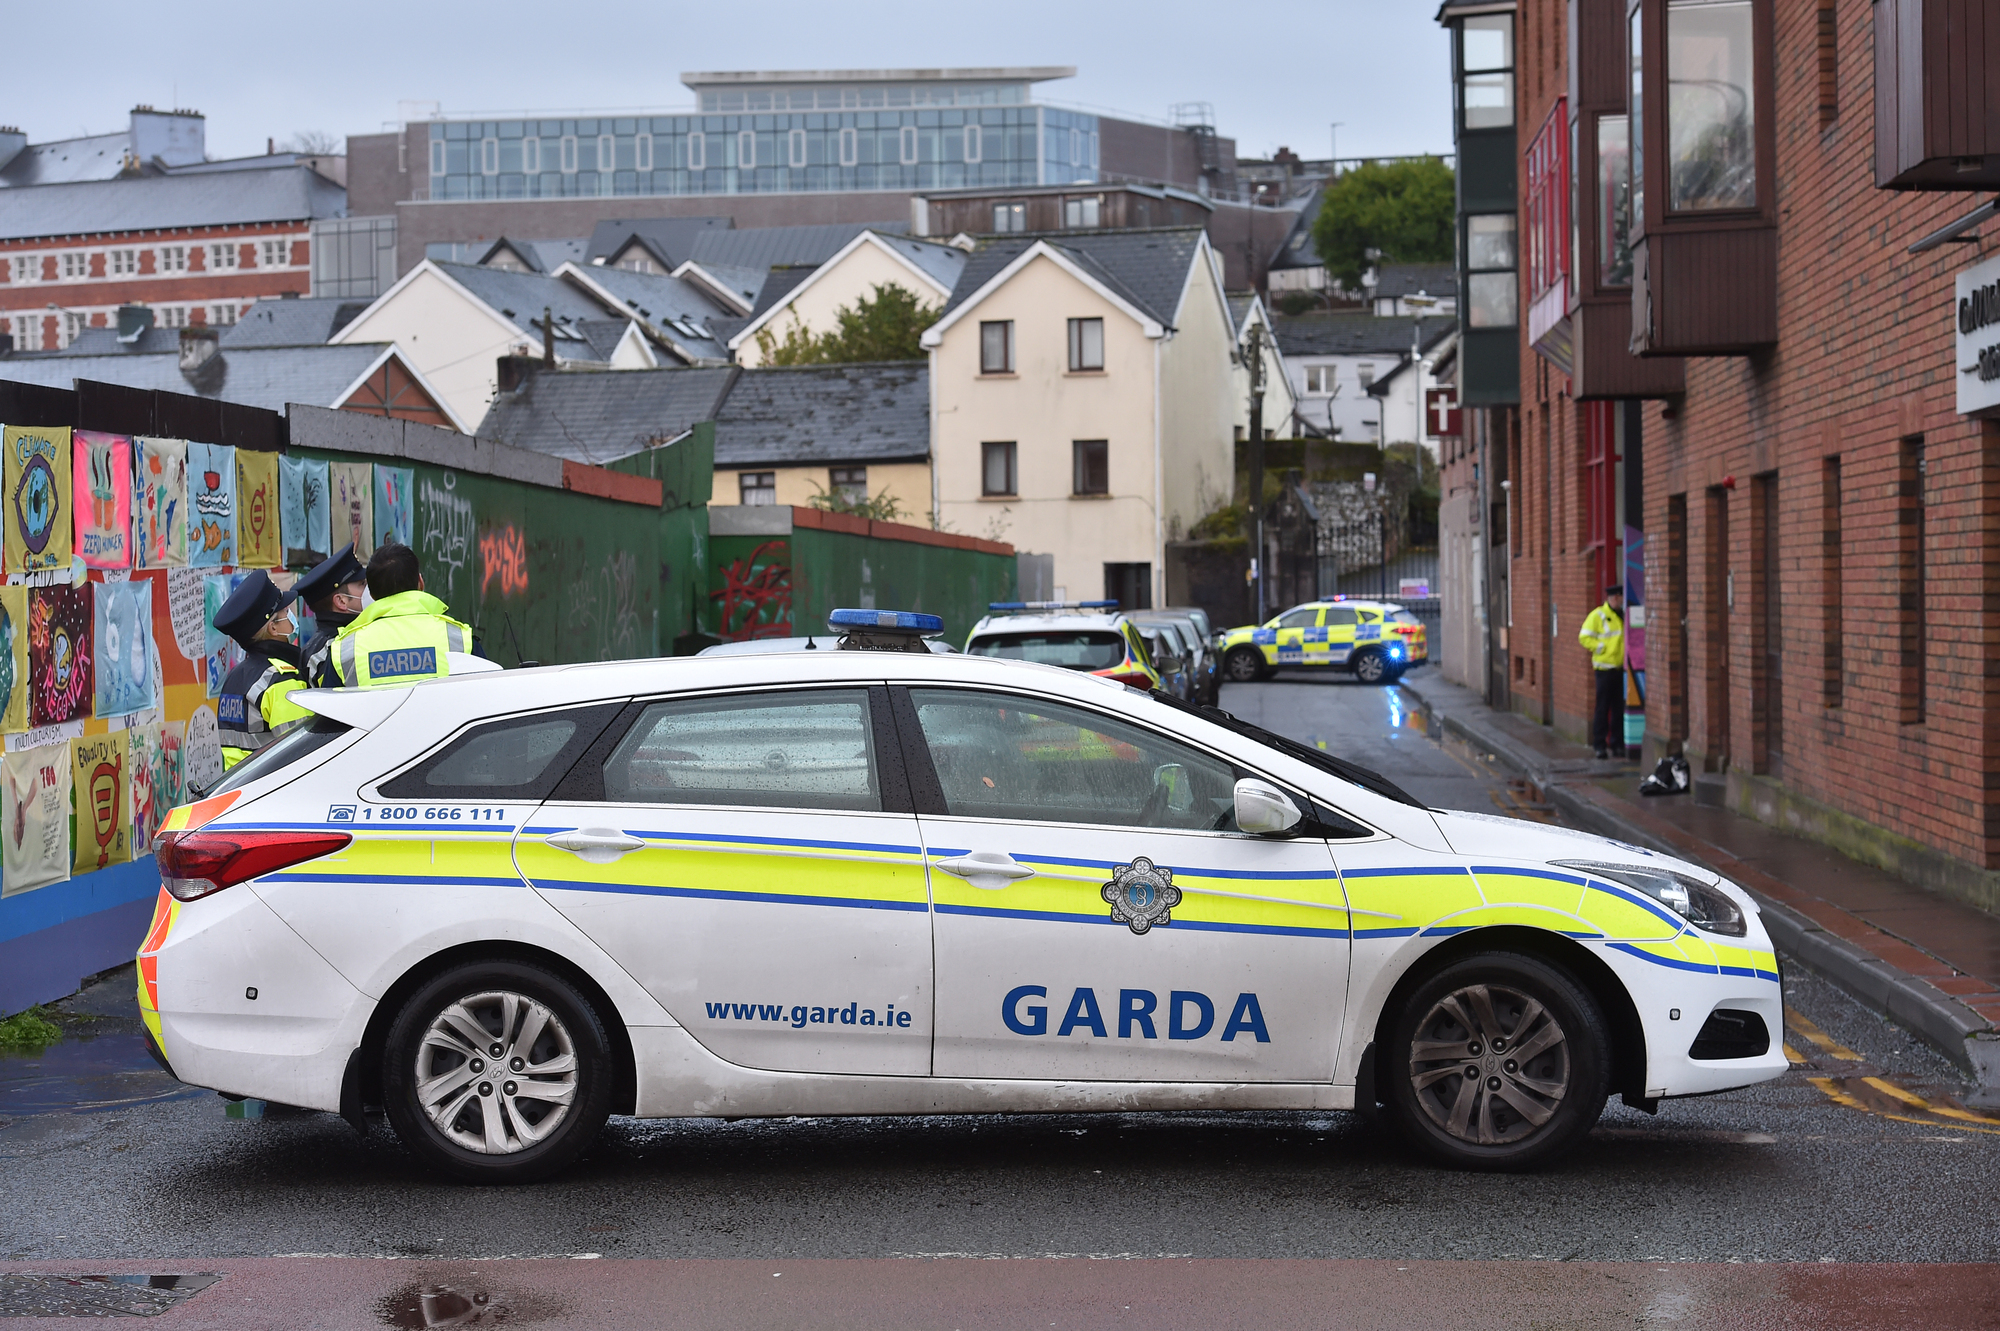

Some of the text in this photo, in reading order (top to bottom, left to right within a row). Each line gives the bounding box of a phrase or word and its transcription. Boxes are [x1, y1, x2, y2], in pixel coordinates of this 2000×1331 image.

[16, 435, 57, 467] CLIMATE
[135, 440, 147, 569] WATER
[83, 533, 124, 555] ZERO HUNGER
[43, 633, 91, 722] RECOVER
[370, 650, 435, 676] GARDA
[219, 696, 244, 720] GARDA
[362, 807, 505, 821] 1 800 666 111
[704, 999, 913, 1029] www.garda.ie
[1001, 984, 1273, 1044] GARDA
